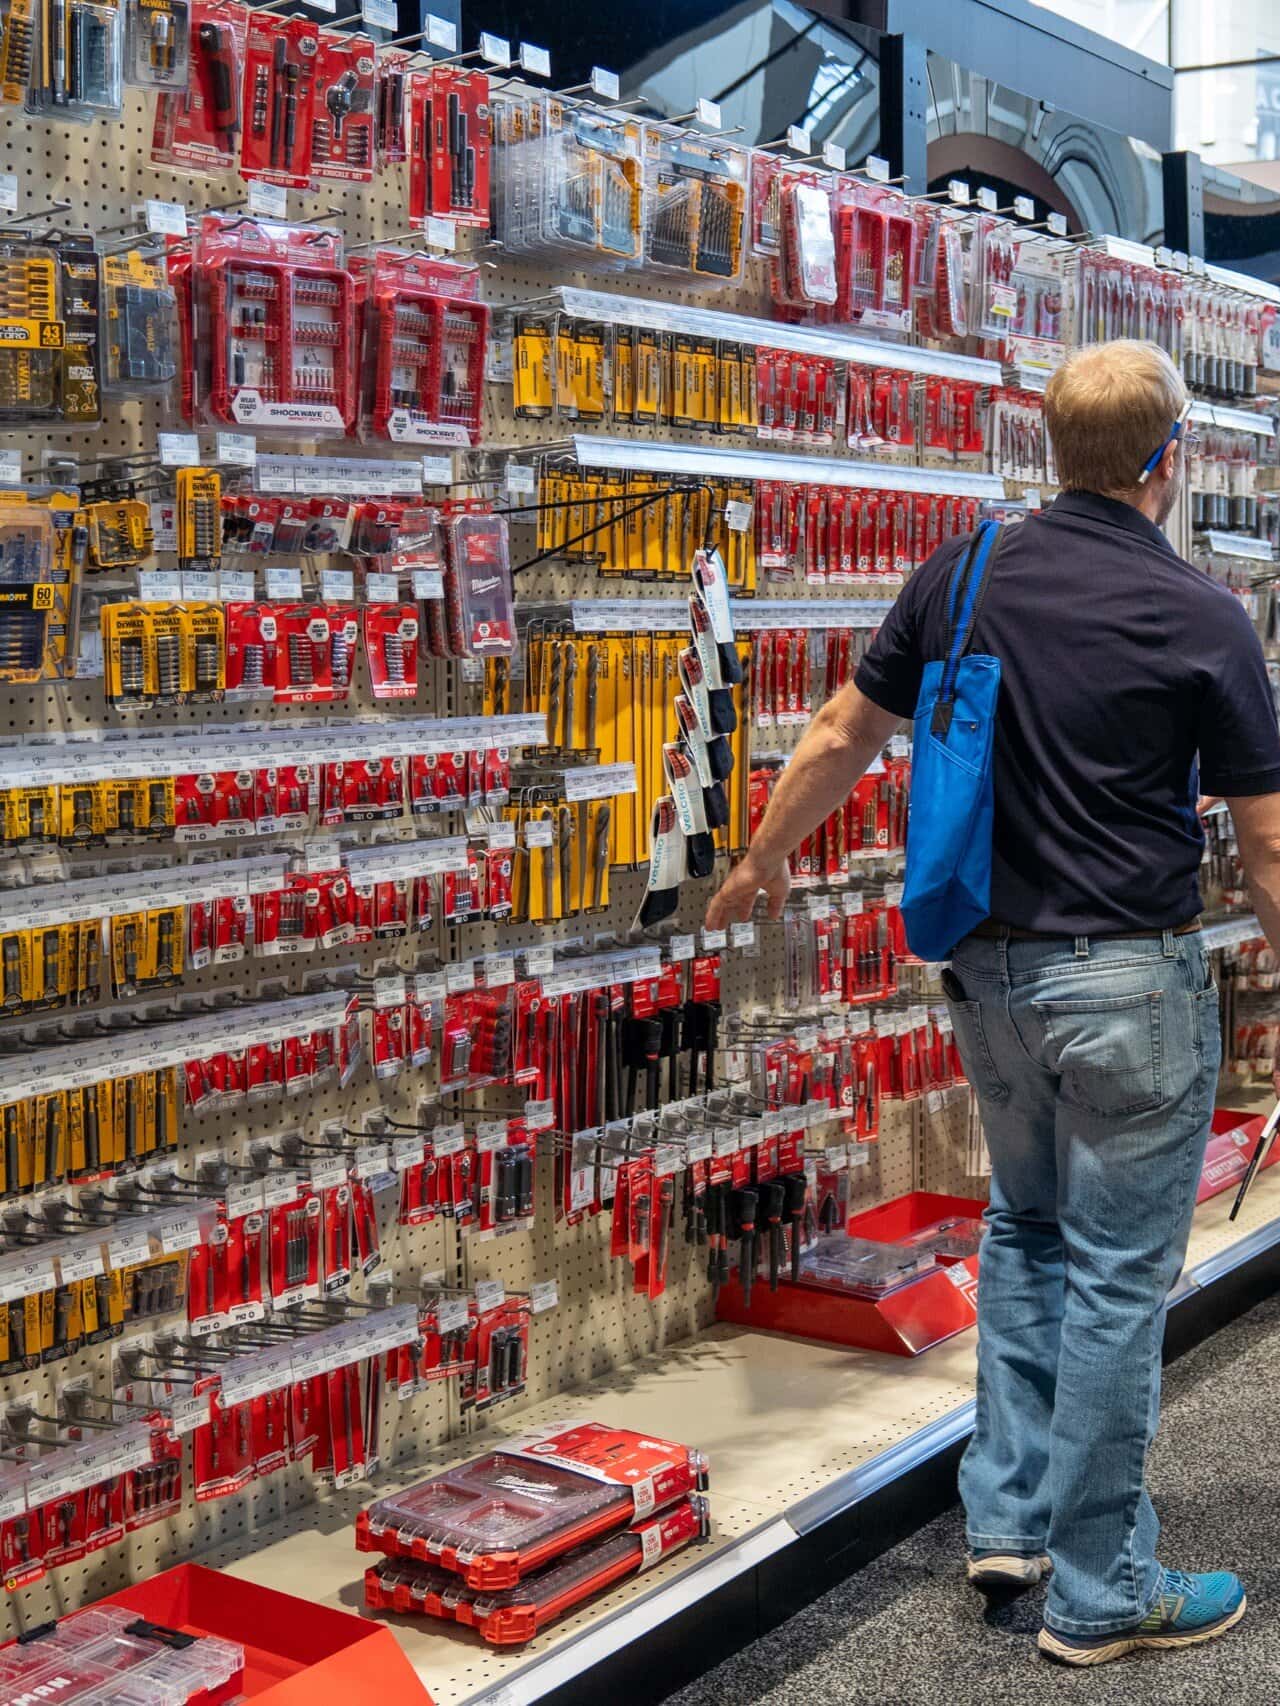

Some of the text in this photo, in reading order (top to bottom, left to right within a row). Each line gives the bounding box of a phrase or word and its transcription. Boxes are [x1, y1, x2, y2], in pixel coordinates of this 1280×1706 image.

[43, 325, 60, 338] 43
[18, 351, 31, 400] DEWALT
[270, 409, 323, 418] SHOCKWAVE
[36, 587, 51, 599] 60
[153, 618, 182, 626] DEWALT
